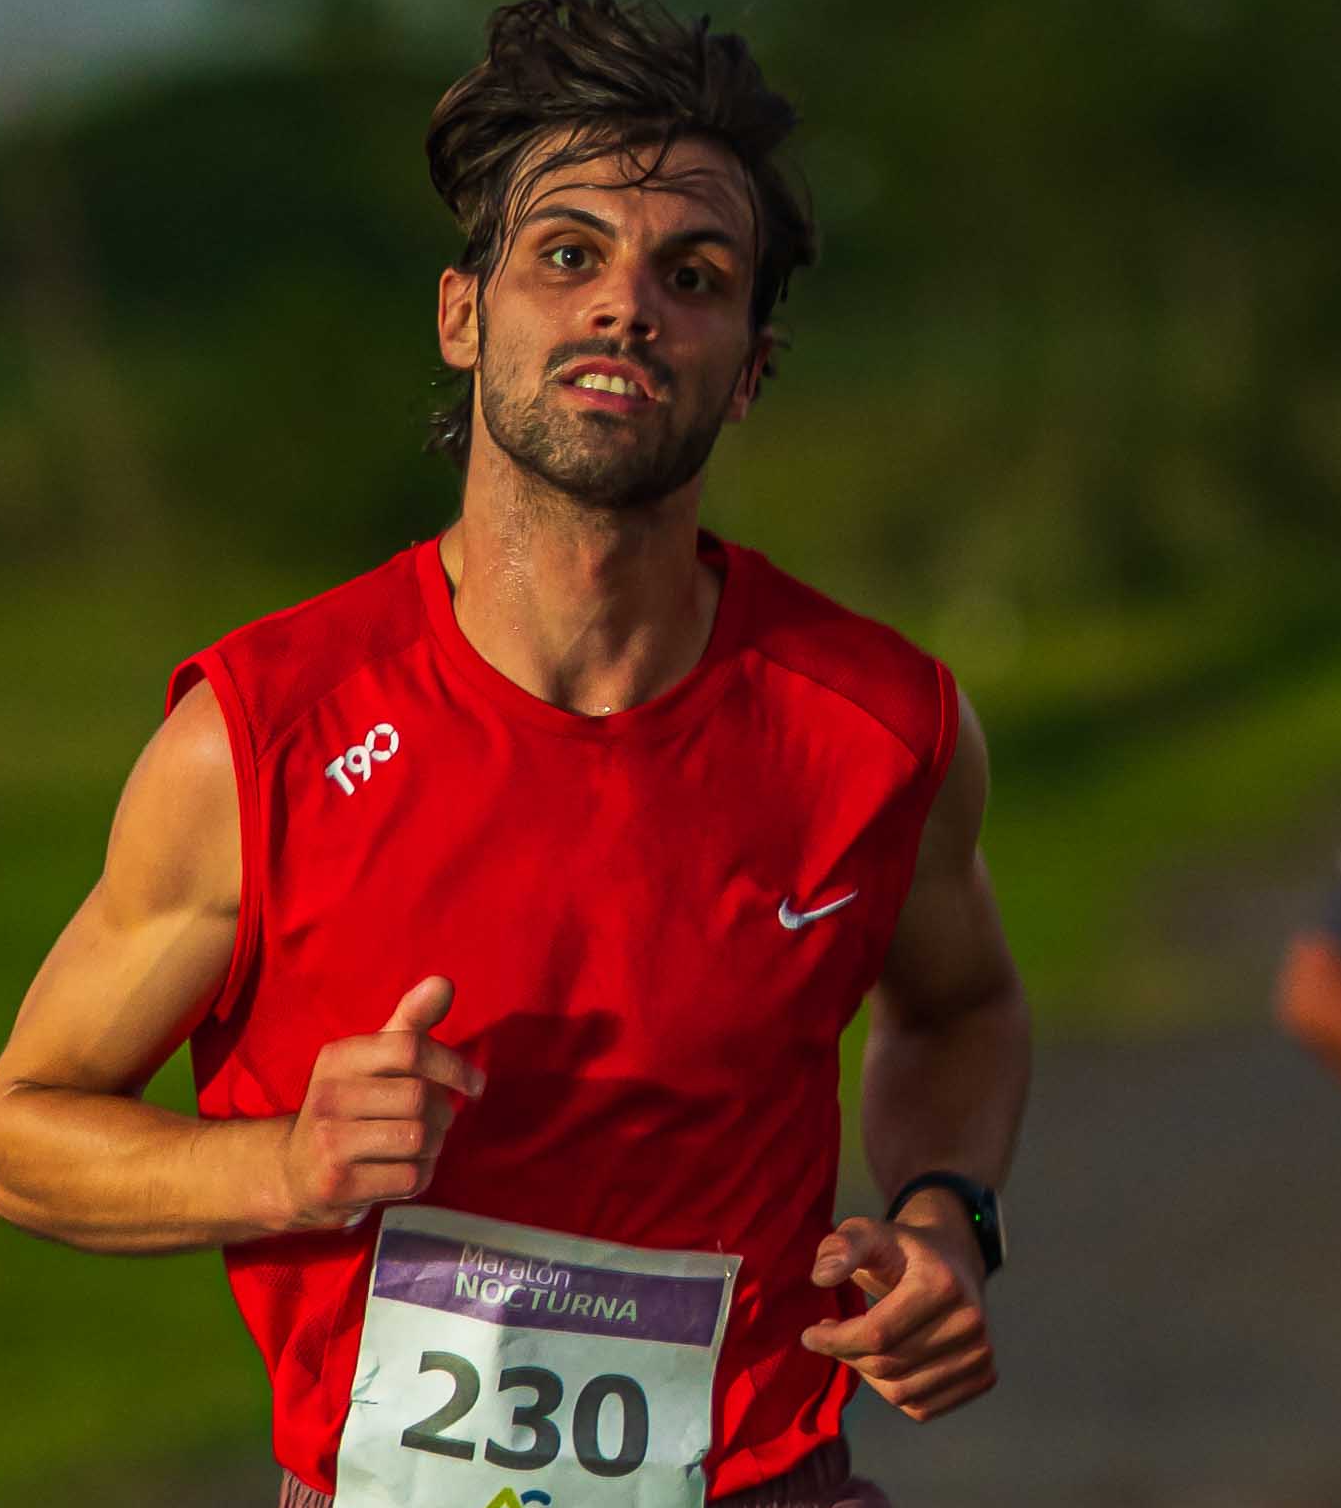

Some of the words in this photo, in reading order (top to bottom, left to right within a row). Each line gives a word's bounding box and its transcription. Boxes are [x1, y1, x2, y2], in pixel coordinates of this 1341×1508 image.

[324, 723, 399, 796] T90
[454, 1271, 638, 1322] NOCTURNA
[459, 1243, 571, 1289] Maratón
[401, 1350, 650, 1478] 230
